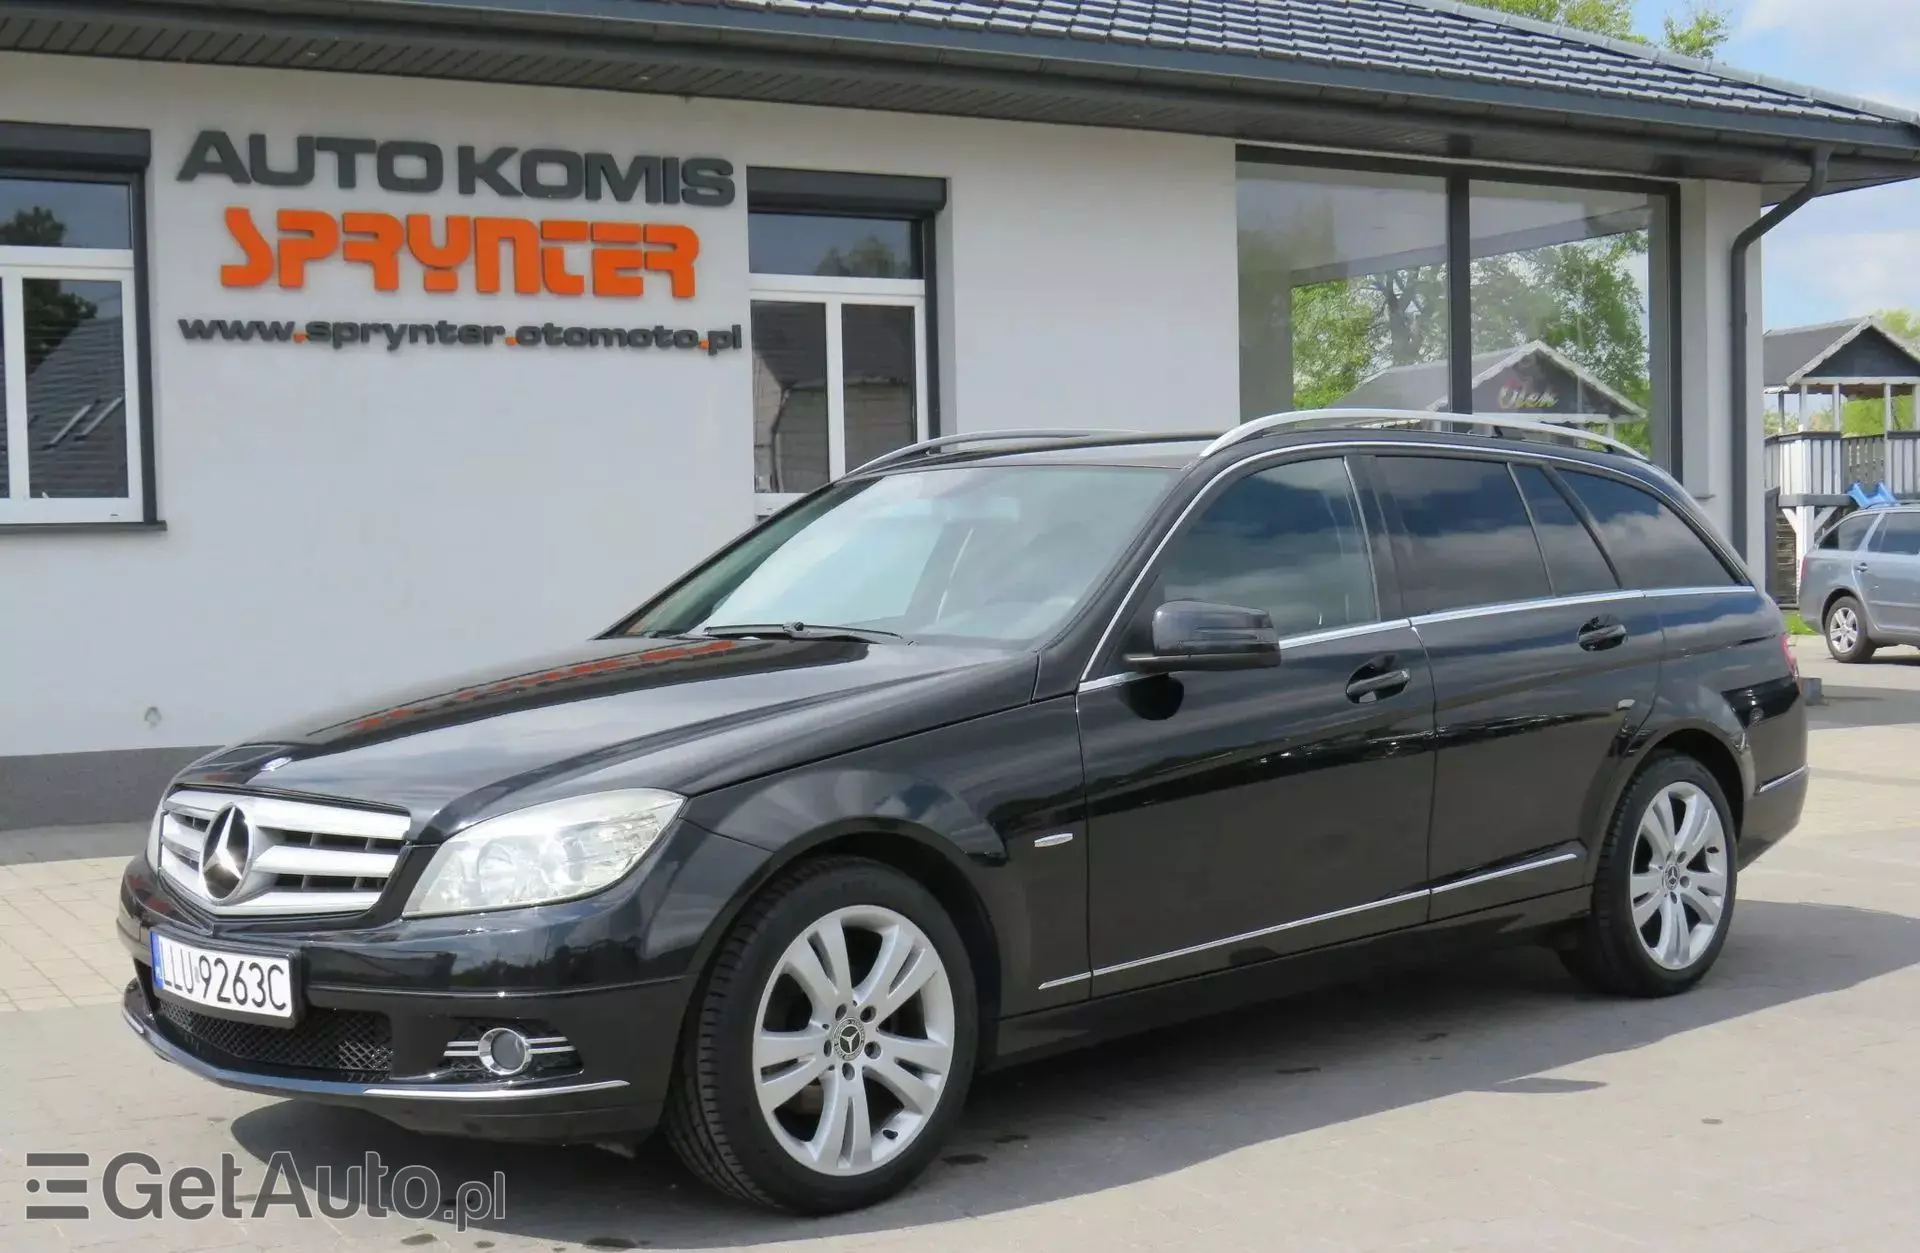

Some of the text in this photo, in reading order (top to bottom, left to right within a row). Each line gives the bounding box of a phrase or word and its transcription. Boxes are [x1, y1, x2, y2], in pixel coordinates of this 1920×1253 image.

[176, 130, 736, 206] AUTO KOMIS
[220, 207, 700, 298] SPRYNTER
[179, 317, 743, 356] www.sprynter.otomoto.pl
